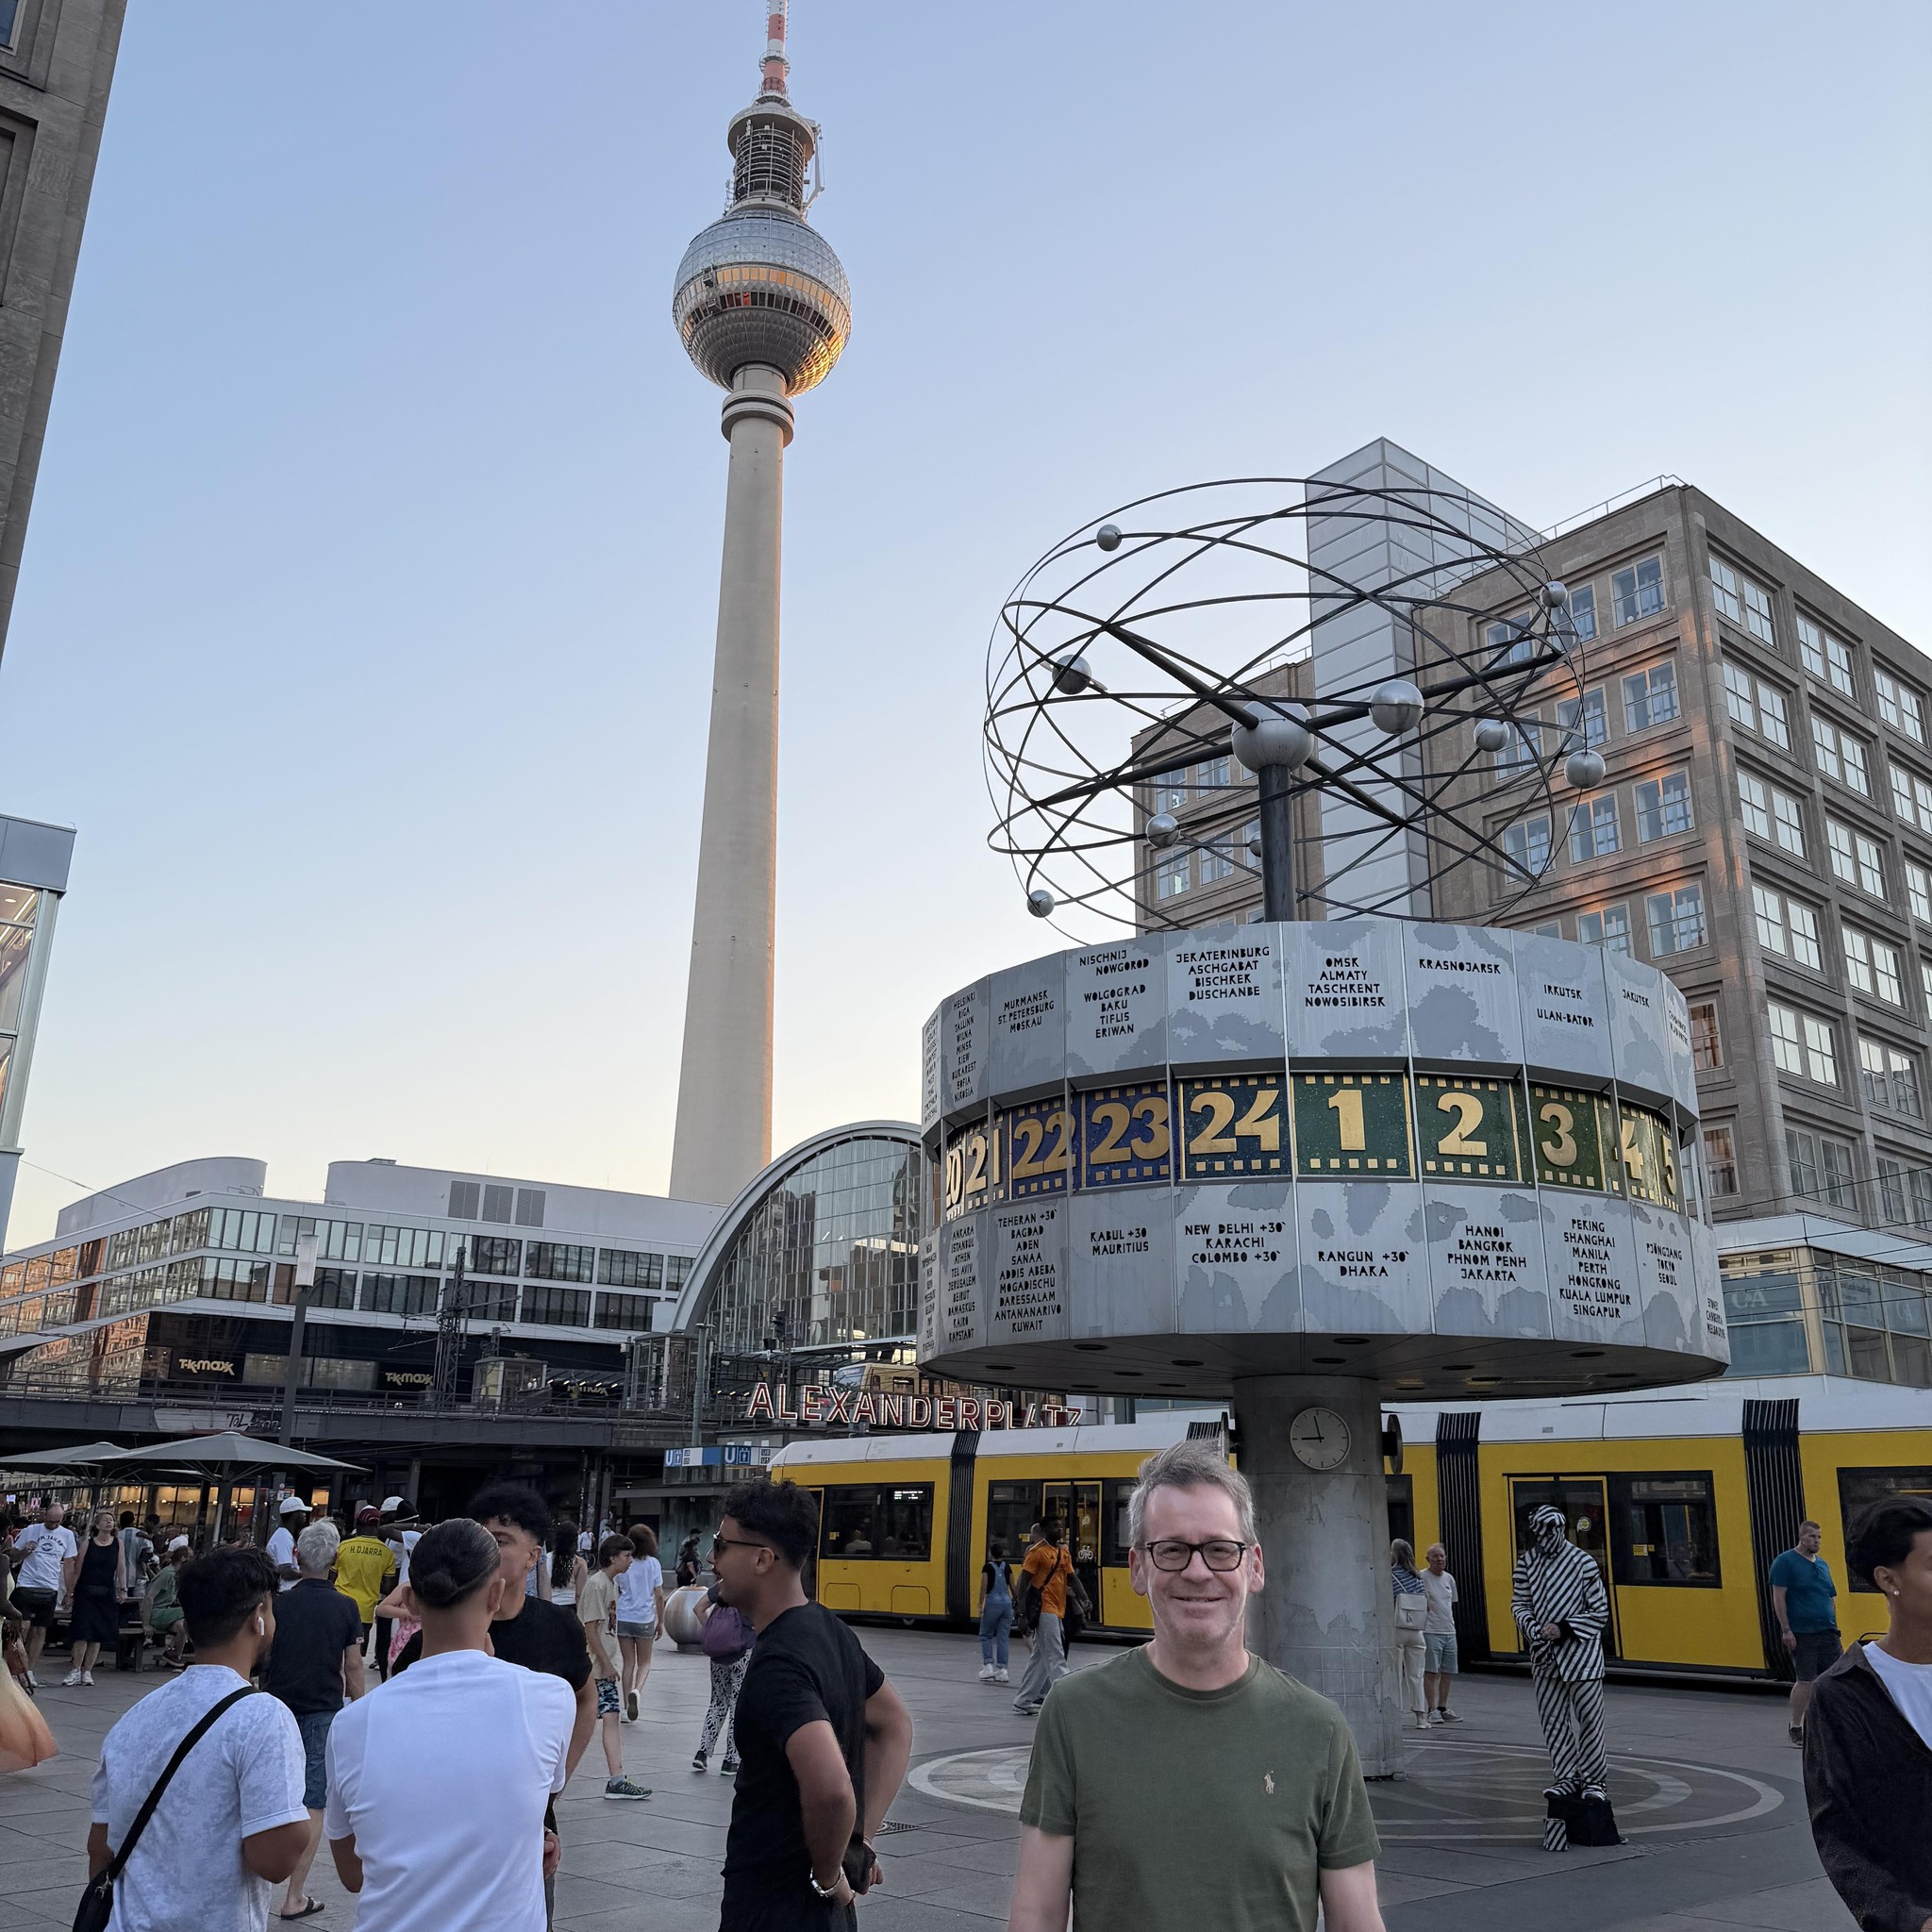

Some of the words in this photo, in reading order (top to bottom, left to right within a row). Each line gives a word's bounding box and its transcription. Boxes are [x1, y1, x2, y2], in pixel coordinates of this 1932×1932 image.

[1079, 950, 1127, 966] NISCHNIJ
[1176, 947, 1270, 963] JEKATERINBURG
[1096, 958, 1149, 975] NOWGOROD
[1189, 960, 1258, 975] ASCHGABAT
[1326, 958, 1358, 968] OMSK
[1419, 958, 1501, 974] KRASNOJARSK
[1195, 974, 1251, 987] BISCHKEK
[1320, 970, 1368, 981] ALMATY
[1084, 985, 1146, 1002] WOLGOGRAD
[1189, 987, 1260, 1000] DUSCHANBE
[1308, 983, 1380, 993] TASCHKENT
[1543, 985, 1583, 1000] IRKUTSK
[954, 991, 975, 1010] HELSINKI
[1004, 990, 1048, 1011] MURMANSK
[1101, 1000, 1128, 1012] BAKU
[1306, 997, 1385, 1007] NOWOSIBIRSK
[1623, 989, 1650, 1008] JAKUTSK
[958, 1008, 970, 1019] RIGA
[998, 1015, 1008, 1024] ST.
[1009, 1000, 1055, 1022] PETERSBURG
[1100, 1012, 1130, 1024] TIFLIS
[1537, 1008, 1594, 1027] ULAN-BATOR
[955, 1015, 974, 1032] TALLINN
[1009, 1016, 1042, 1033] MOSKAU
[1096, 1024, 1134, 1038] ERIWAN
[957, 1029, 972, 1042] WILNA
[957, 1040, 972, 1055] MINSK
[958, 1053, 970, 1066] KIEW
[953, 1061, 976, 1080] BUKAREST
[957, 1076, 971, 1090] SOFIA
[955, 1087, 974, 1103] NIKOSIA
[1190, 1090, 1280, 1155] 24
[1328, 1090, 1366, 1151] 1
[1437, 1092, 1487, 1157] 2
[1091, 1097, 1169, 1165] 23
[1540, 1103, 1577, 1167] 3
[1013, 1110, 1075, 1179] 22
[1614, 1119, 1643, 1179] 4
[966, 1128, 1000, 1194] 21
[1662, 1136, 1677, 1195] 5
[998, 1213, 1036, 1228] TEHERAN
[1572, 1219, 1605, 1232] PEKING
[953, 1225, 974, 1240] ANKARA
[1011, 1225, 1043, 1240] BAGDAD
[1091, 1228, 1124, 1241] KABUL
[1185, 1224, 1210, 1236] NEW
[1219, 1223, 1254, 1234] DELHI
[1466, 1224, 1504, 1238] HANOI
[951, 1238, 974, 1253] ISTANBUL
[1016, 1240, 1039, 1252] ADEN
[1206, 1238, 1264, 1249] KARACHI
[1458, 1240, 1513, 1253] BANGKOK
[1564, 1232, 1615, 1247] SHANGHAI
[1092, 1241, 1149, 1256] MAURITIUS
[1573, 1247, 1610, 1260] MANILA
[1646, 1243, 1683, 1260] PJÖNGJANG
[955, 1252, 970, 1264] ATHEN
[1011, 1253, 1042, 1265] SANAA
[1192, 1251, 1247, 1264] COLOMBO
[1318, 1251, 1374, 1262] RANGUN
[1447, 1253, 1491, 1266] PHNOM
[1496, 1256, 1526, 1268] PENH
[951, 1267, 959, 1277] TEL
[960, 1264, 974, 1276] AVIV
[1000, 1268, 1024, 1281] ADDIS
[1028, 1264, 1056, 1275] ABEBA
[1340, 1266, 1389, 1277] DHAKA
[1579, 1261, 1607, 1274] PERTH
[1657, 1258, 1675, 1272] TOKYO
[1461, 1269, 1517, 1281] JAKARTA
[1658, 1274, 1677, 1286] SEOUL
[948, 1275, 975, 1291] JERUSALEM
[1000, 1277, 1055, 1294] MOGADISCHU
[1568, 1275, 1621, 1291] HONGKONG
[953, 1291, 970, 1303] BEIRUT
[1000, 1291, 1056, 1307] DARESSALAM
[1559, 1289, 1591, 1302] KUALA
[1595, 1292, 1631, 1306] LUMPUR
[948, 1302, 975, 1317] DAMASKUS
[994, 1304, 1061, 1321] ANTANANARIVO
[1574, 1304, 1621, 1319] SINGAPUR
[953, 1317, 968, 1328] KAIRO
[1011, 1321, 1043, 1333] KUWAIT
[949, 1328, 974, 1343] KAPSTADT
[748, 1382, 1083, 1430] ALEXANDERPLATZ
[666, 1449, 674, 1466] U
[724, 1447, 736, 1464] U
